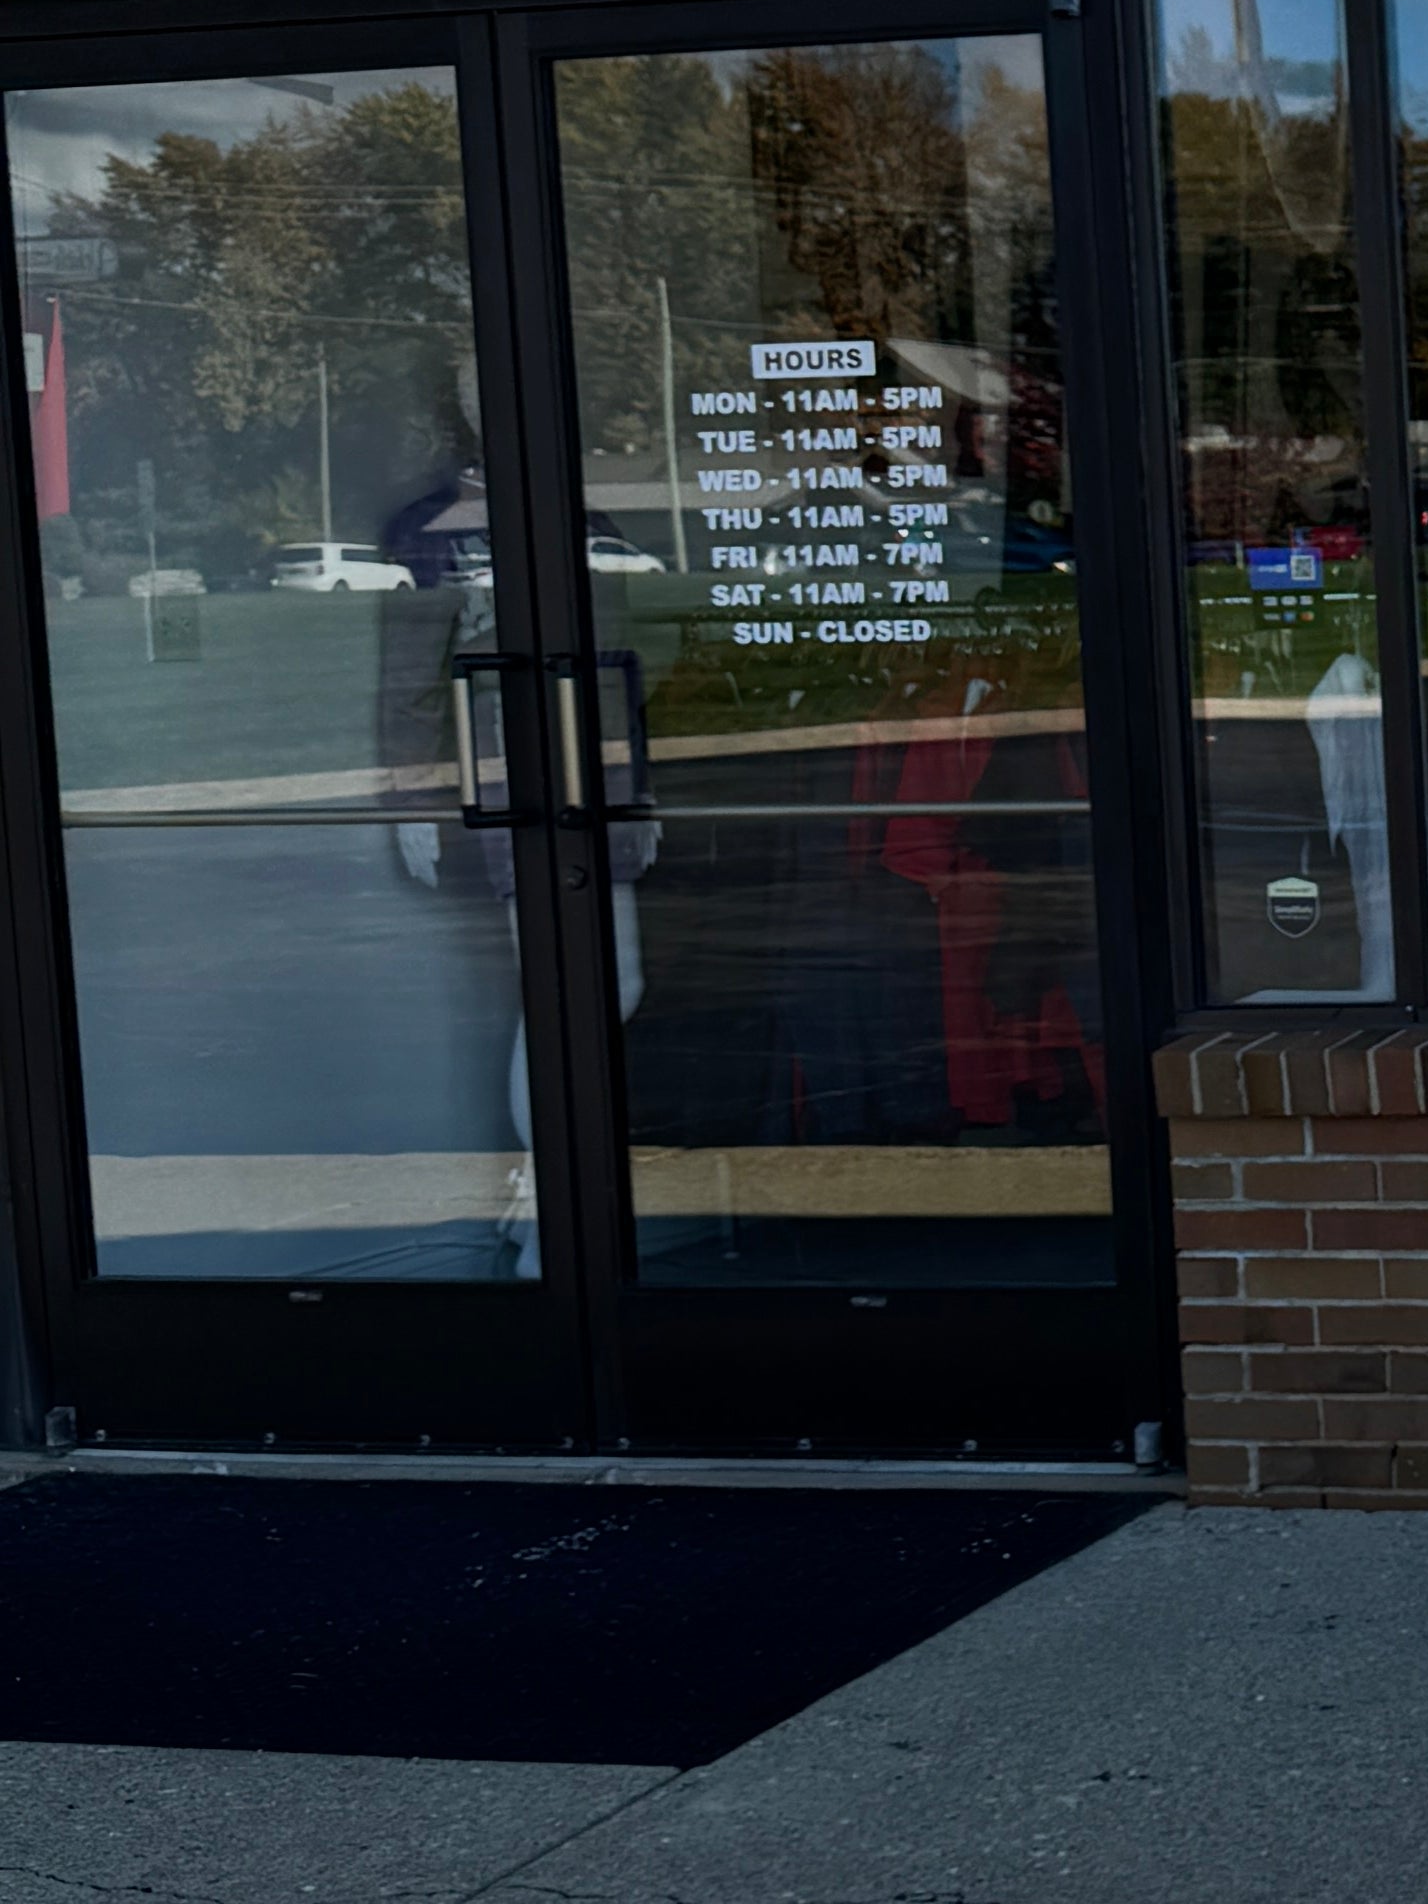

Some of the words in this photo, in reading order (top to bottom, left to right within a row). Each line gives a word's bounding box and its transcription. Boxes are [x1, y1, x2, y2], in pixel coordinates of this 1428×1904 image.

[763, 348, 863, 372] HOURS
[691, 391, 757, 415] MON
[781, 388, 859, 413] 11AM
[882, 386, 943, 410] 5PM
[697, 430, 757, 454] TUE
[780, 427, 858, 452] 11AM
[881, 425, 942, 450] 5PM
[697, 469, 762, 493] WED
[785, 465, 864, 490] 11AM
[887, 463, 948, 488] 5PM
[702, 507, 763, 532] THU
[787, 504, 865, 529] 11AM
[888, 502, 948, 527] 5PM
[711, 546, 758, 569] FRI
[781, 544, 860, 569] 11AM
[882, 541, 943, 567] 7PM
[711, 583, 766, 607] SAT
[788, 581, 865, 605] 11AM
[888, 580, 950, 603] 7PM
[733, 621, 794, 645] SUN
[817, 619, 932, 643] CLOSED
